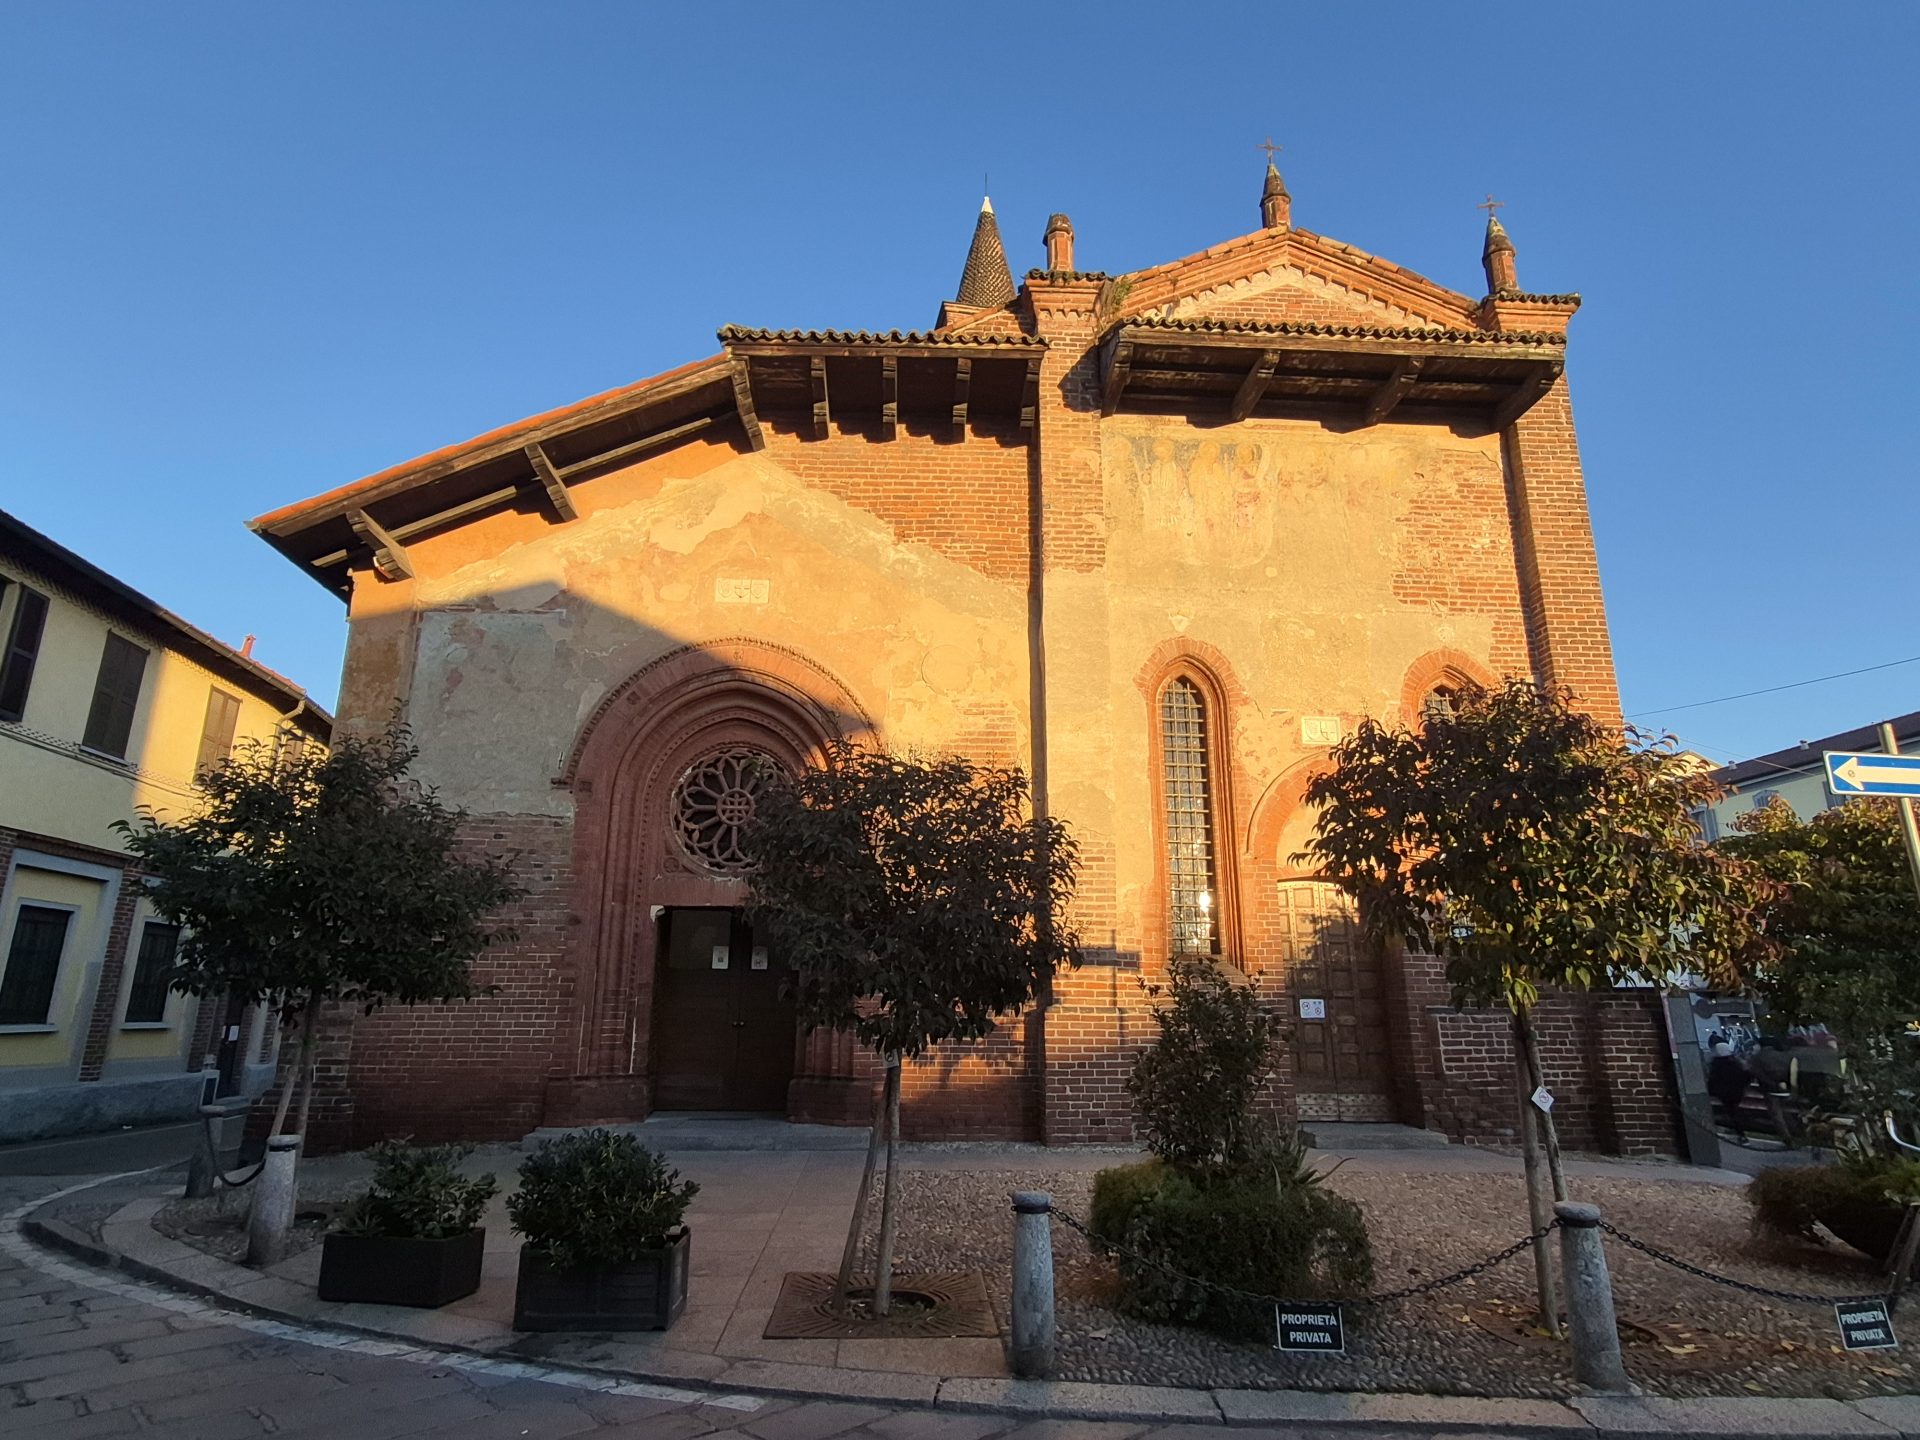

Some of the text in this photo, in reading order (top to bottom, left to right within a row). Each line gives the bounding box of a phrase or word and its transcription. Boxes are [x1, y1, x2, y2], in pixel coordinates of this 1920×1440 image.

[1281, 1312, 1338, 1326] PROPRIETÀ
[1289, 1331, 1333, 1344] PRIVATA
[1850, 1328, 1886, 1341] PRIVATA
